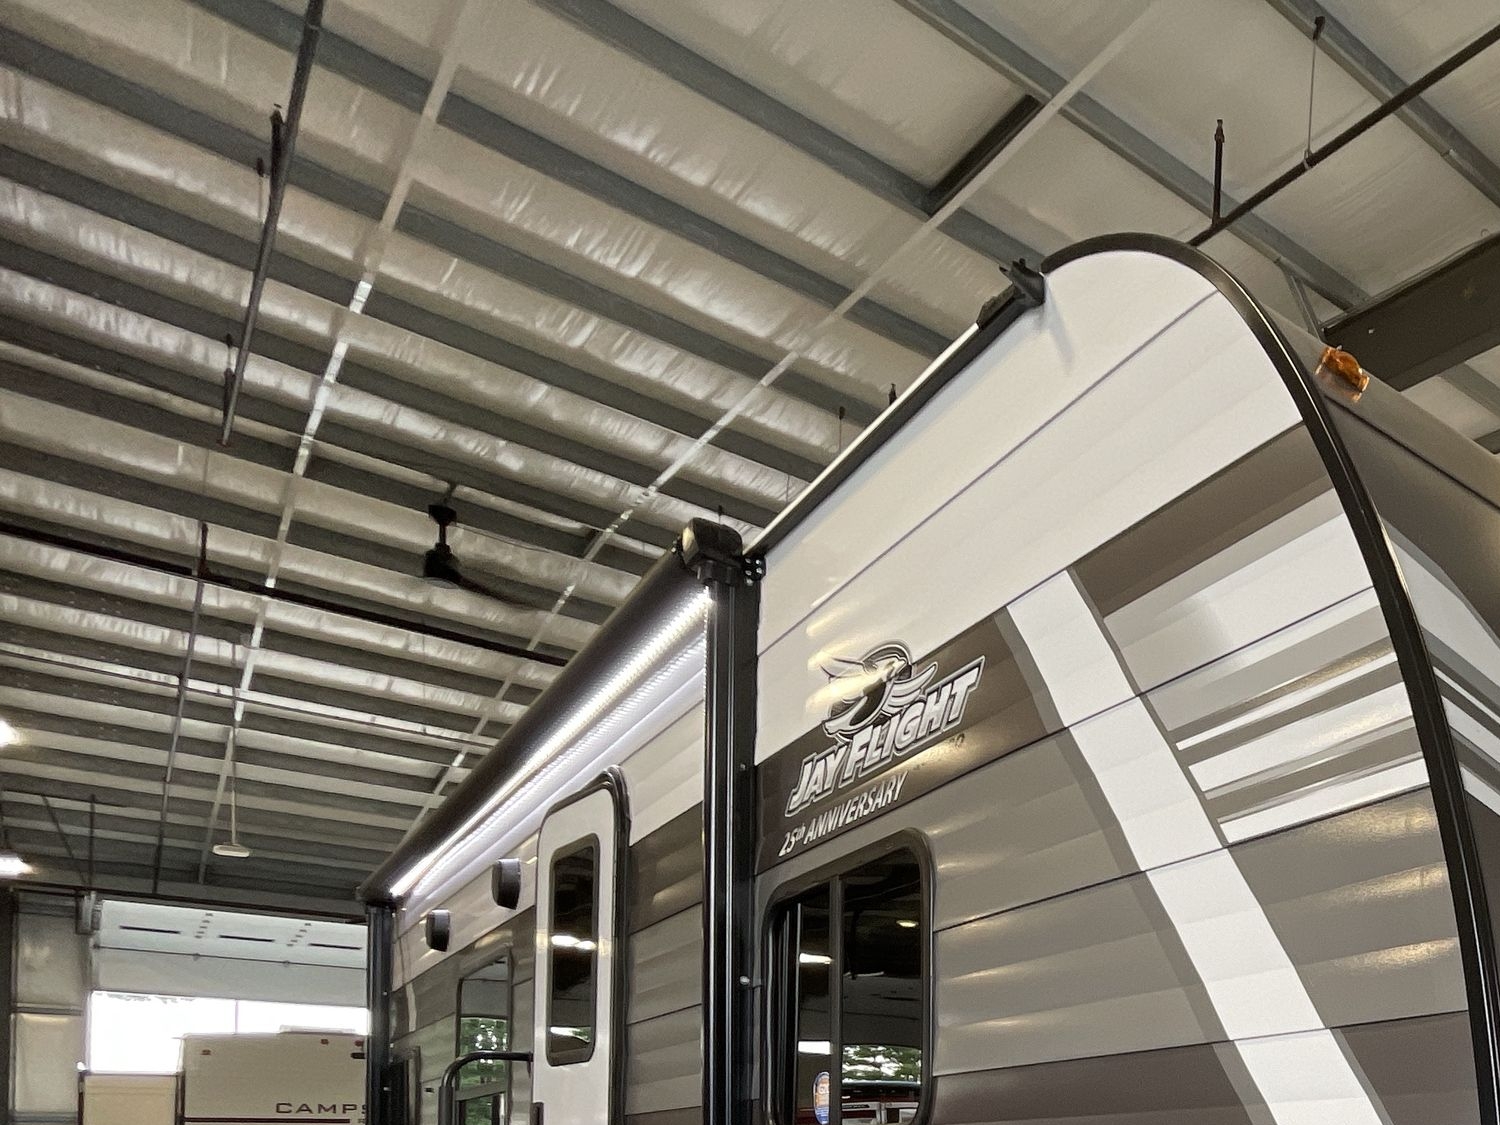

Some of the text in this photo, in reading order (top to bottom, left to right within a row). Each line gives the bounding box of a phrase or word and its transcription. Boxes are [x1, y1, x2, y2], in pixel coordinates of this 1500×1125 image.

[785, 655, 986, 817] JAY FLIGHT
[803, 770, 909, 845] ANNIVERSARY
